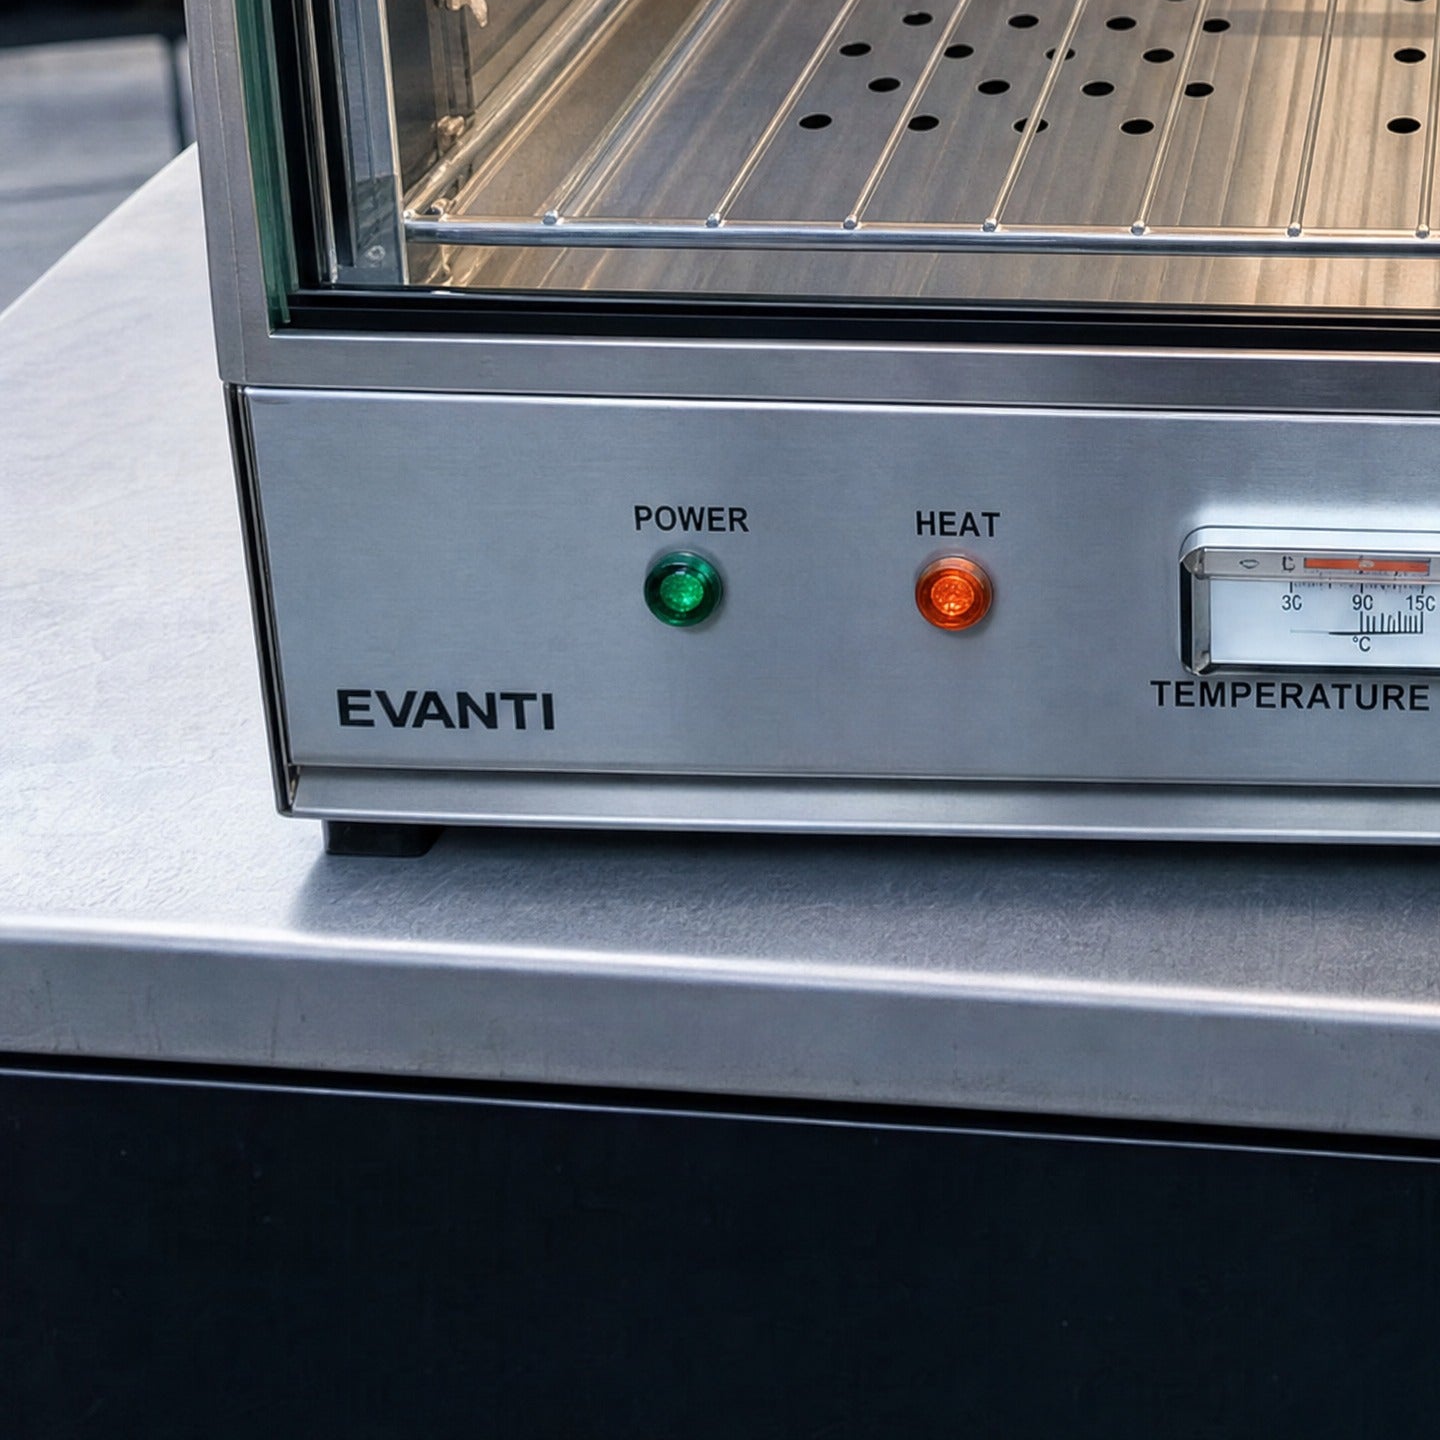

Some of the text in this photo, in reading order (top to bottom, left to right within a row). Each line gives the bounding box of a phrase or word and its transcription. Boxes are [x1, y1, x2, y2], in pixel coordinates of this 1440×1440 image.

[634, 505, 750, 533] POWER
[916, 510, 1001, 538] HEAT
[336, 689, 555, 731] EVANTI
[1150, 679, 1430, 711] TEMPERATURE
